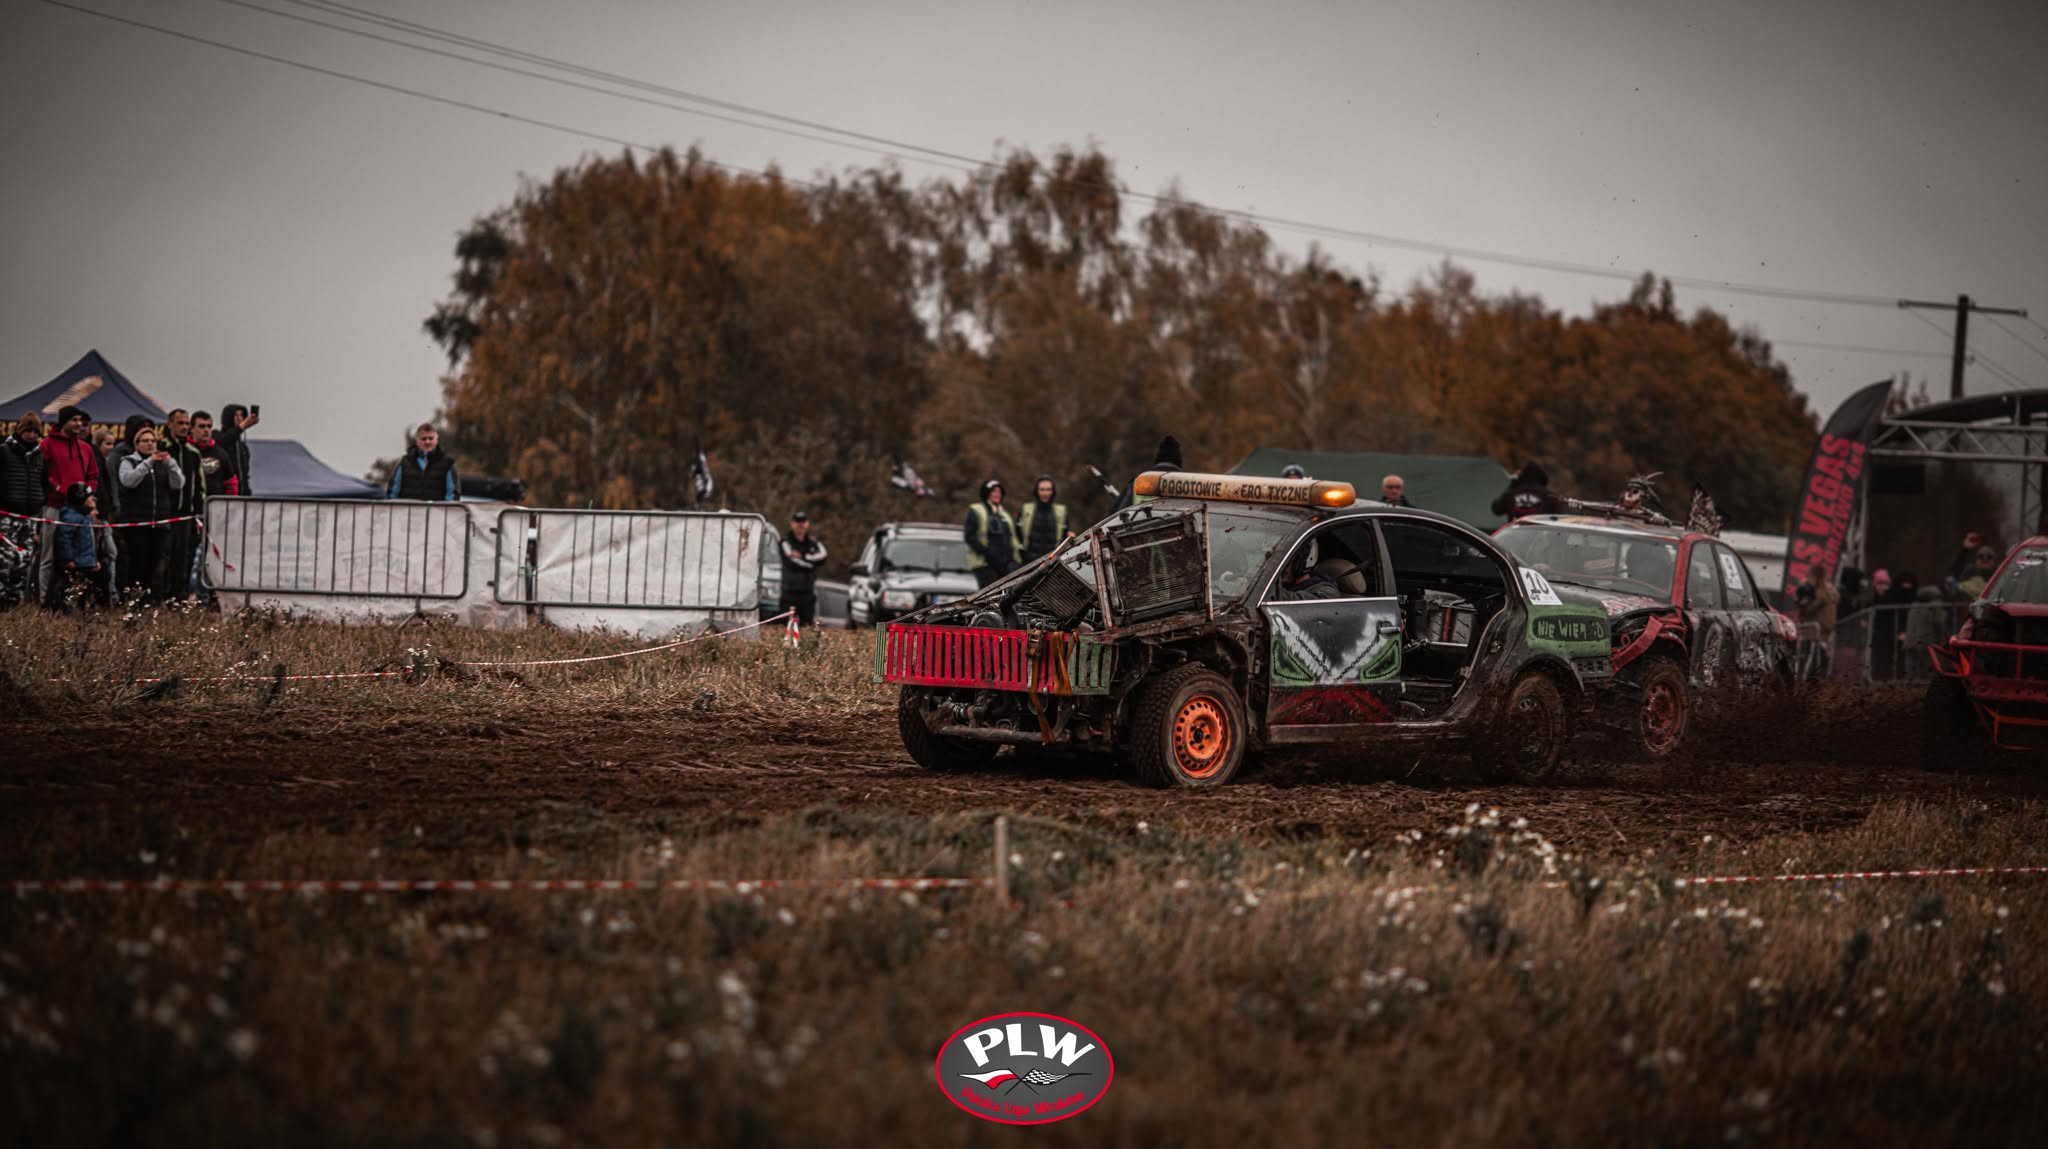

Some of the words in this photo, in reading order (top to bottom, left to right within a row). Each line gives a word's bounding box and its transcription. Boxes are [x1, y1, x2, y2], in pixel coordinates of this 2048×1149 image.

[1161, 479, 1221, 497] POGOTOWIE
[1800, 433, 1850, 537] VEGAS
[1525, 571, 1550, 594] 10
[1537, 620, 1556, 639] NIE
